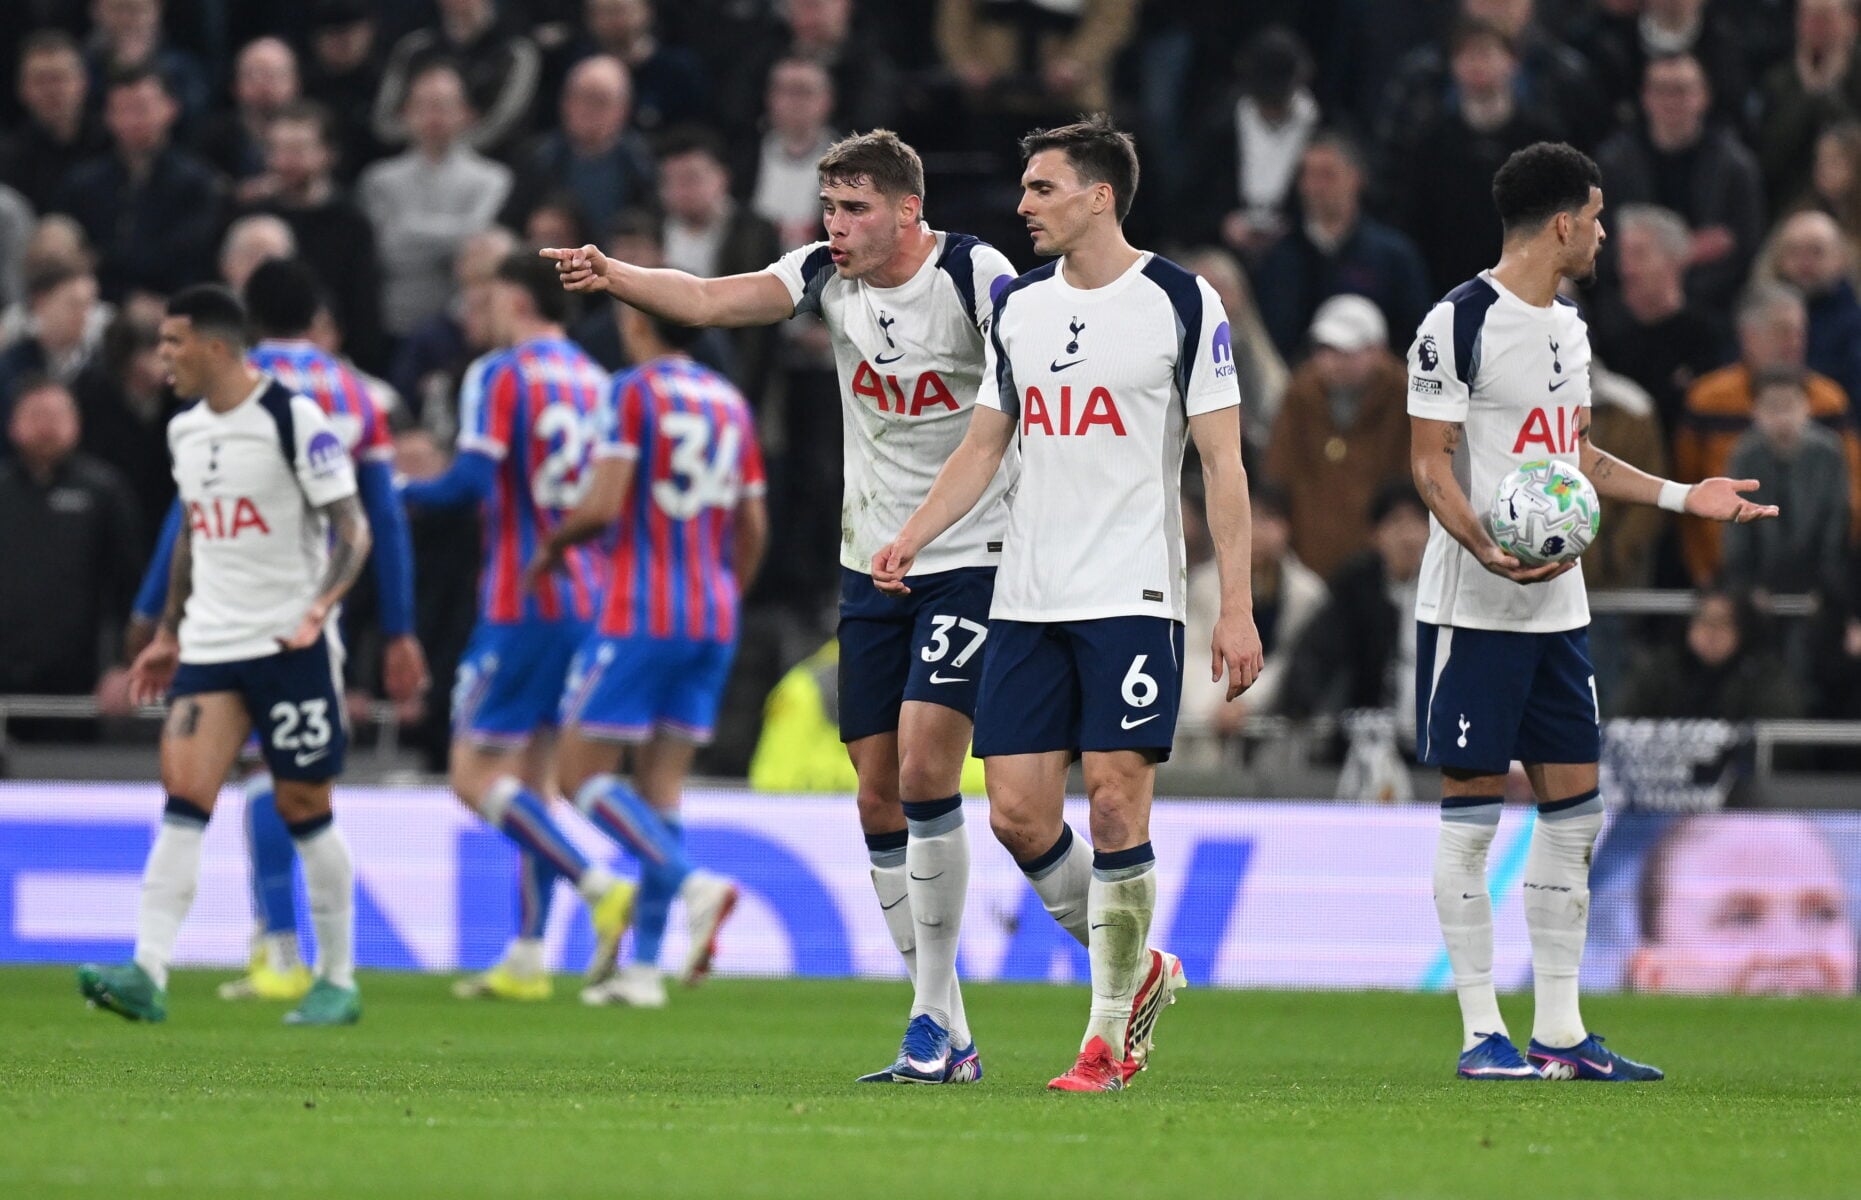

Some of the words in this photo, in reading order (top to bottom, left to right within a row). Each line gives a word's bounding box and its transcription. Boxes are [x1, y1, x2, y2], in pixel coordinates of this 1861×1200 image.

[852, 359, 960, 416] AIA
[1023, 386, 1127, 436] AIA
[652, 410, 740, 520] 34
[191, 496, 271, 540] AIA
[921, 615, 989, 669] 37
[1121, 654, 1159, 708] 6
[269, 698, 333, 749] 23
